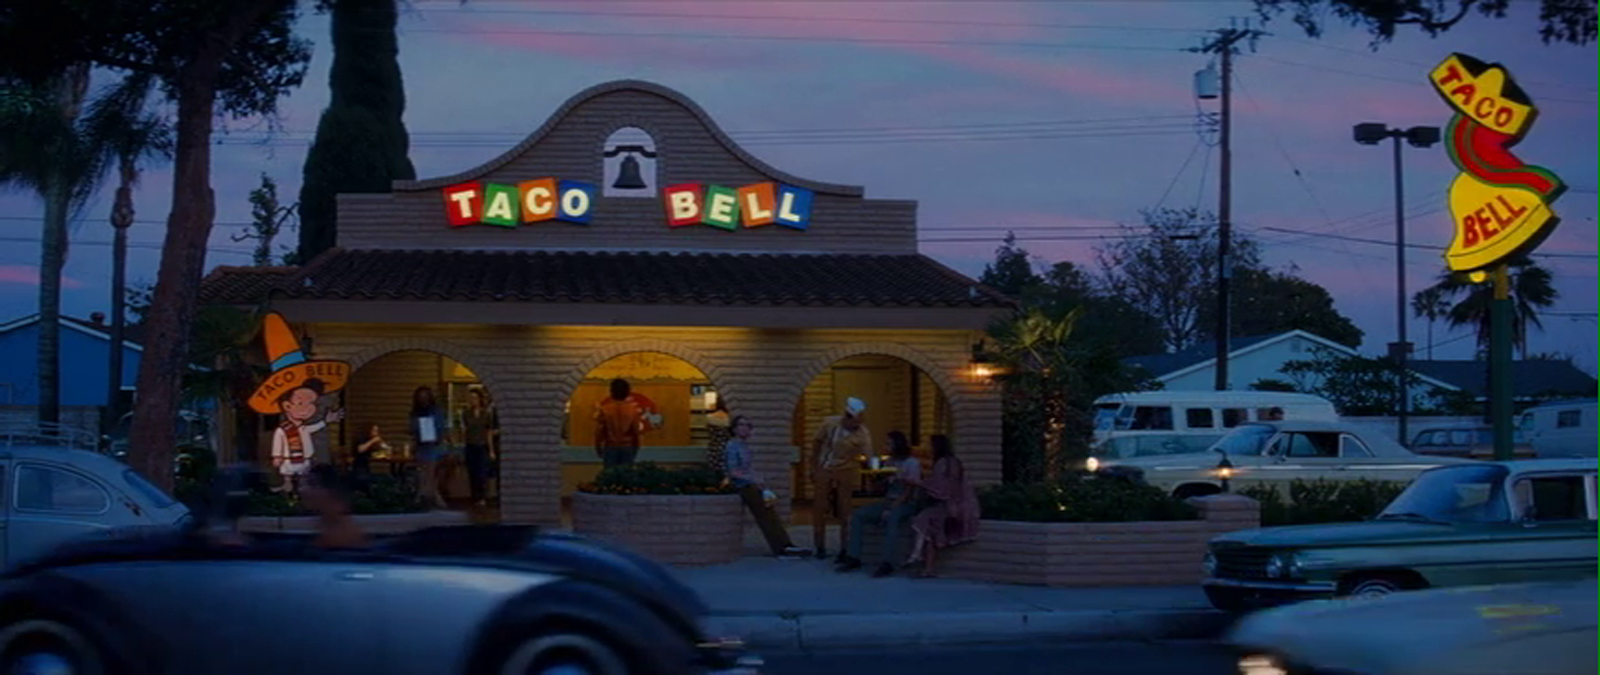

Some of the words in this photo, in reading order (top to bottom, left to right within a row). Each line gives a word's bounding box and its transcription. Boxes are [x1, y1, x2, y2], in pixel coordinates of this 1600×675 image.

[1439, 64, 1514, 128] TACO
[450, 187, 590, 220] TACO
[670, 191, 801, 223] BELL
[1463, 195, 1528, 248] BELL
[257, 370, 296, 400] TACO
[305, 363, 343, 378] BELL
